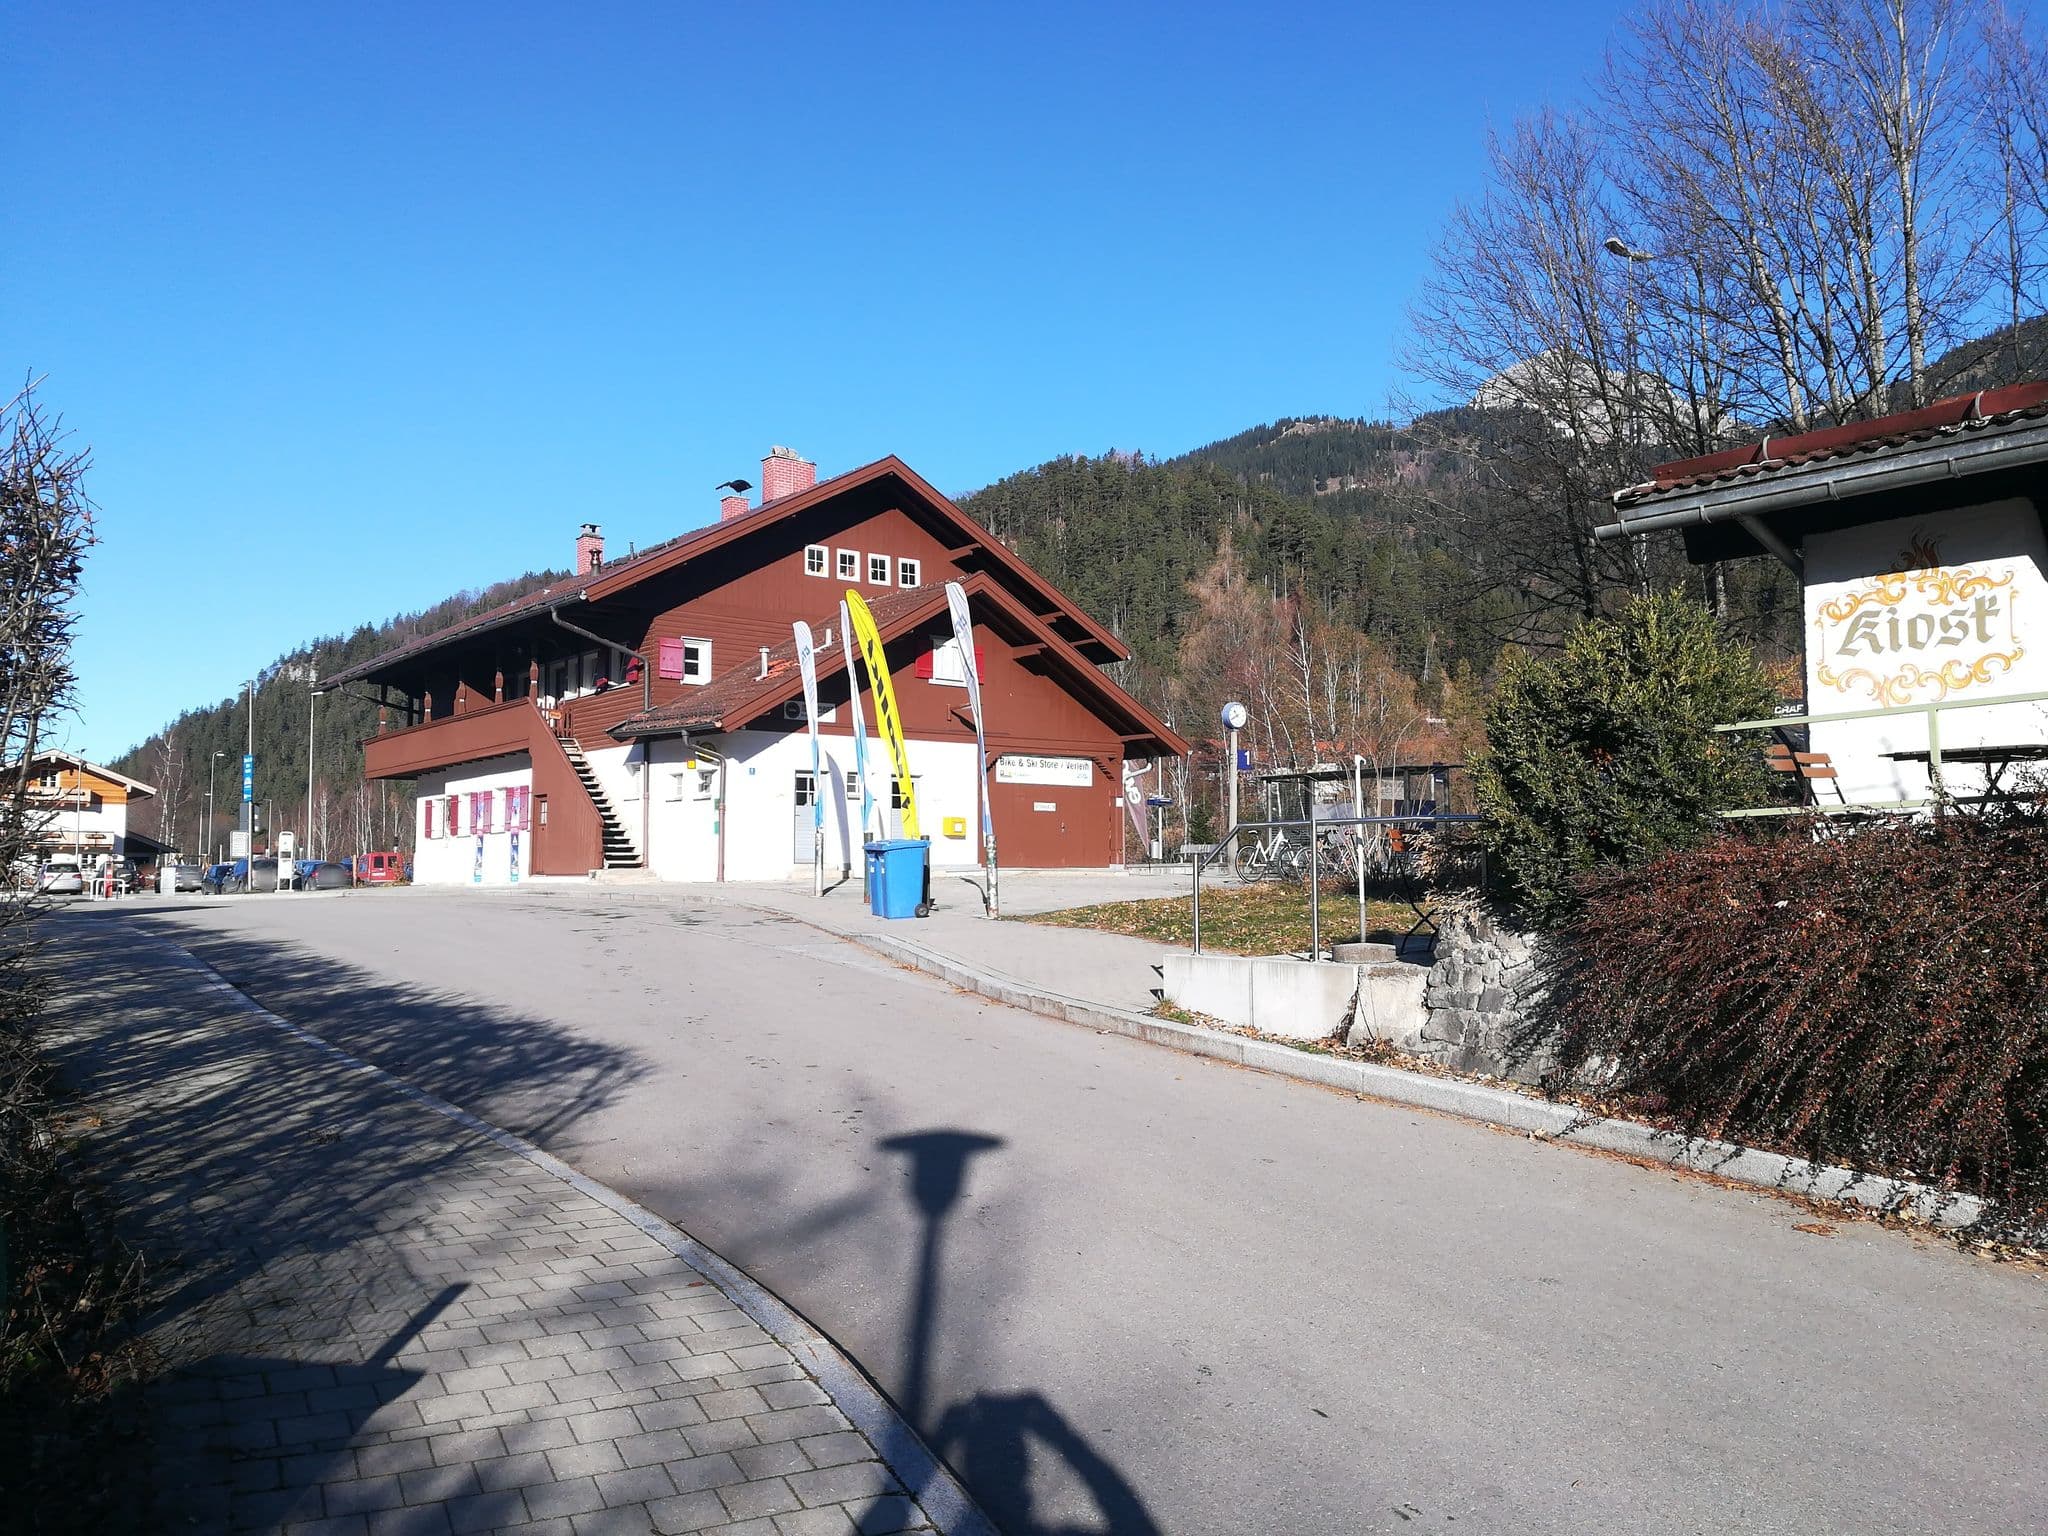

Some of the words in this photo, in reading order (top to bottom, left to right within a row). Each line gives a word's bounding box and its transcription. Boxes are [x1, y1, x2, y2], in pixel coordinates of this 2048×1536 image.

[1836, 595, 2000, 656] Kiosk
[999, 757, 1016, 767] Bike
[1018, 759, 1024, 767] &
[1026, 759, 1038, 768] Ski
[1039, 759, 1059, 769] Store
[1244, 750, 1250, 766] 1
